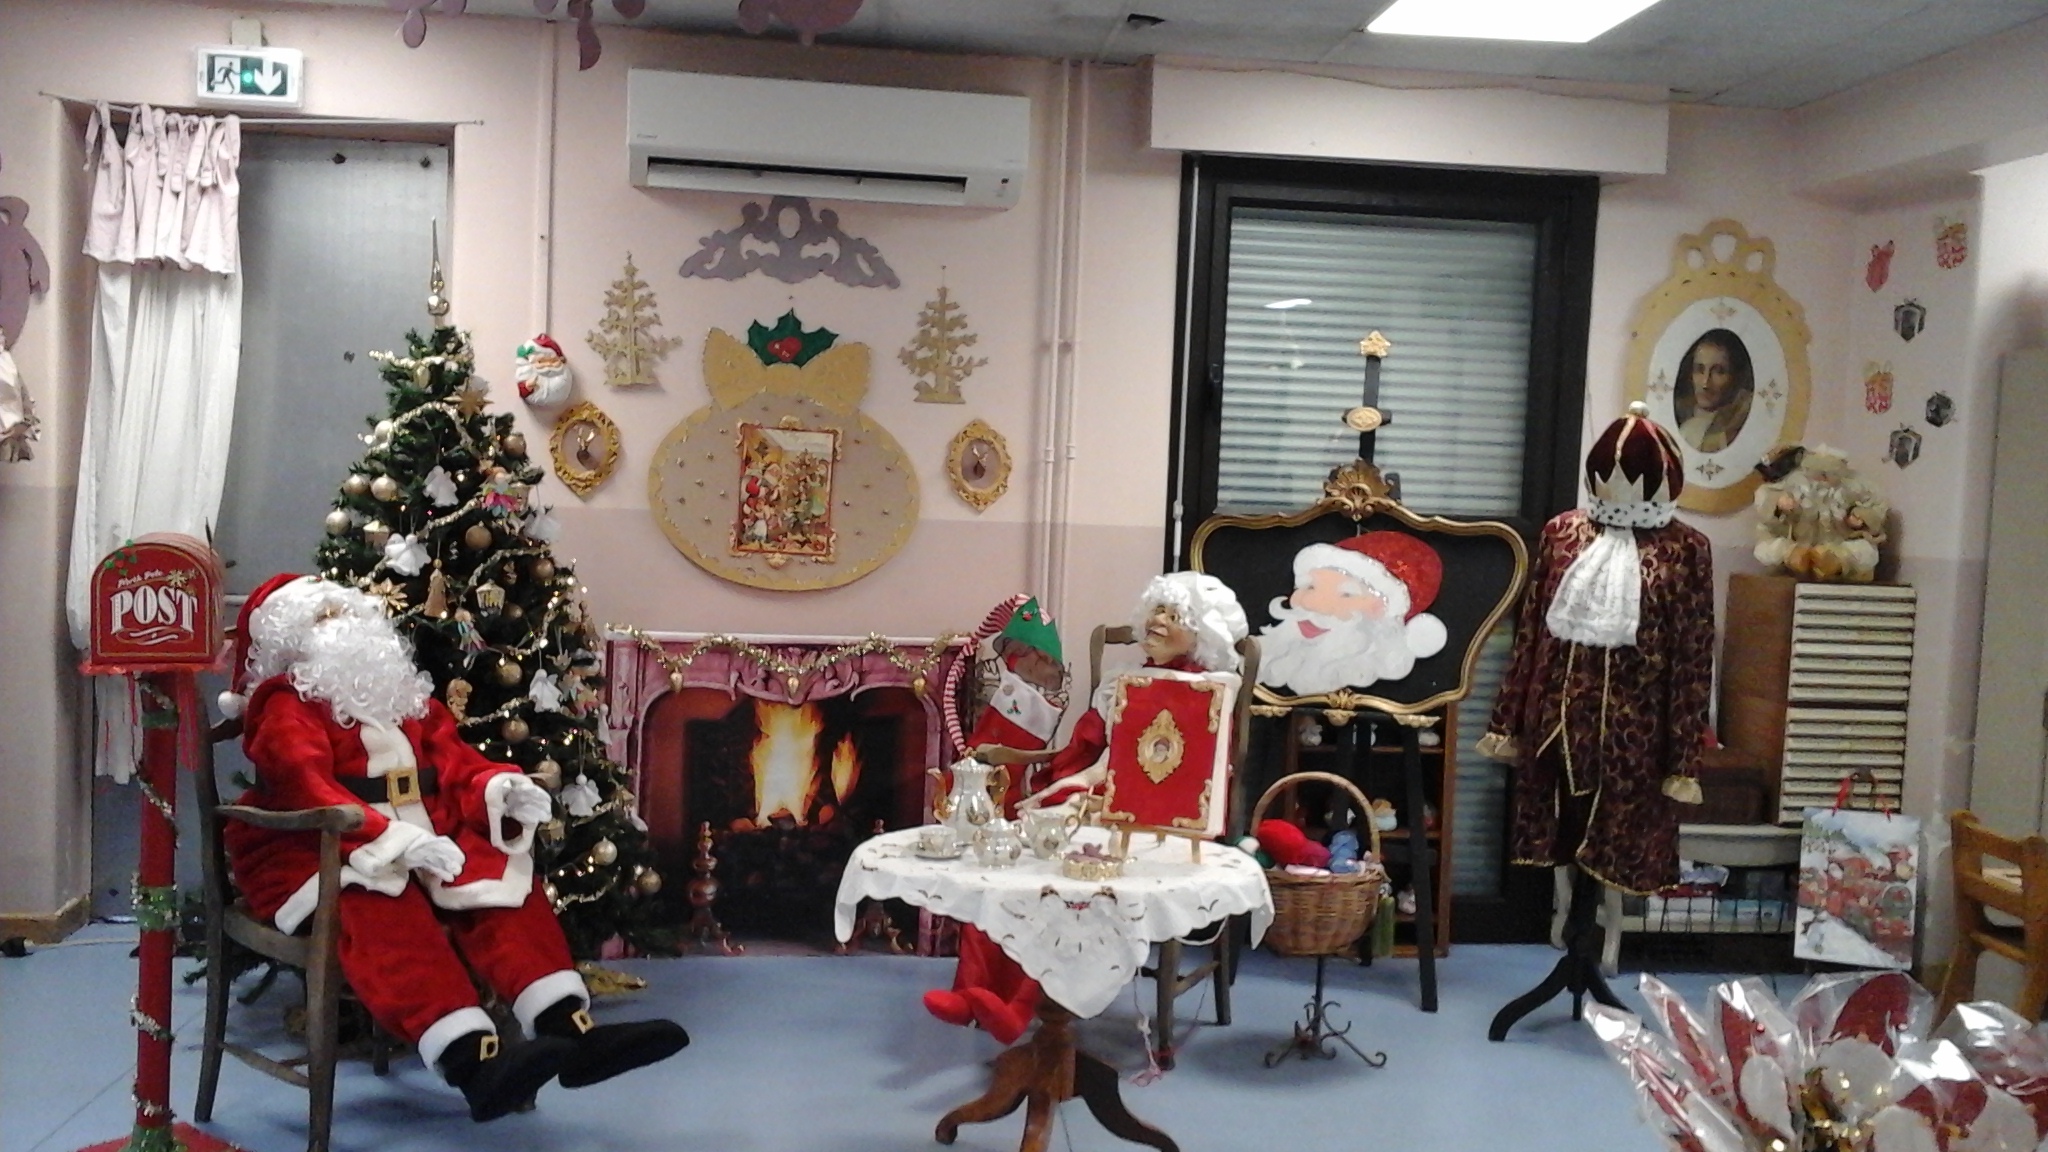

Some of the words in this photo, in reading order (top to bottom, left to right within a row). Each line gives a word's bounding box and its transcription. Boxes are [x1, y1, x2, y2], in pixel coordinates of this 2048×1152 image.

[117, 574, 142, 588] North
[144, 568, 163, 580] Pole
[110, 585, 198, 635] POST
